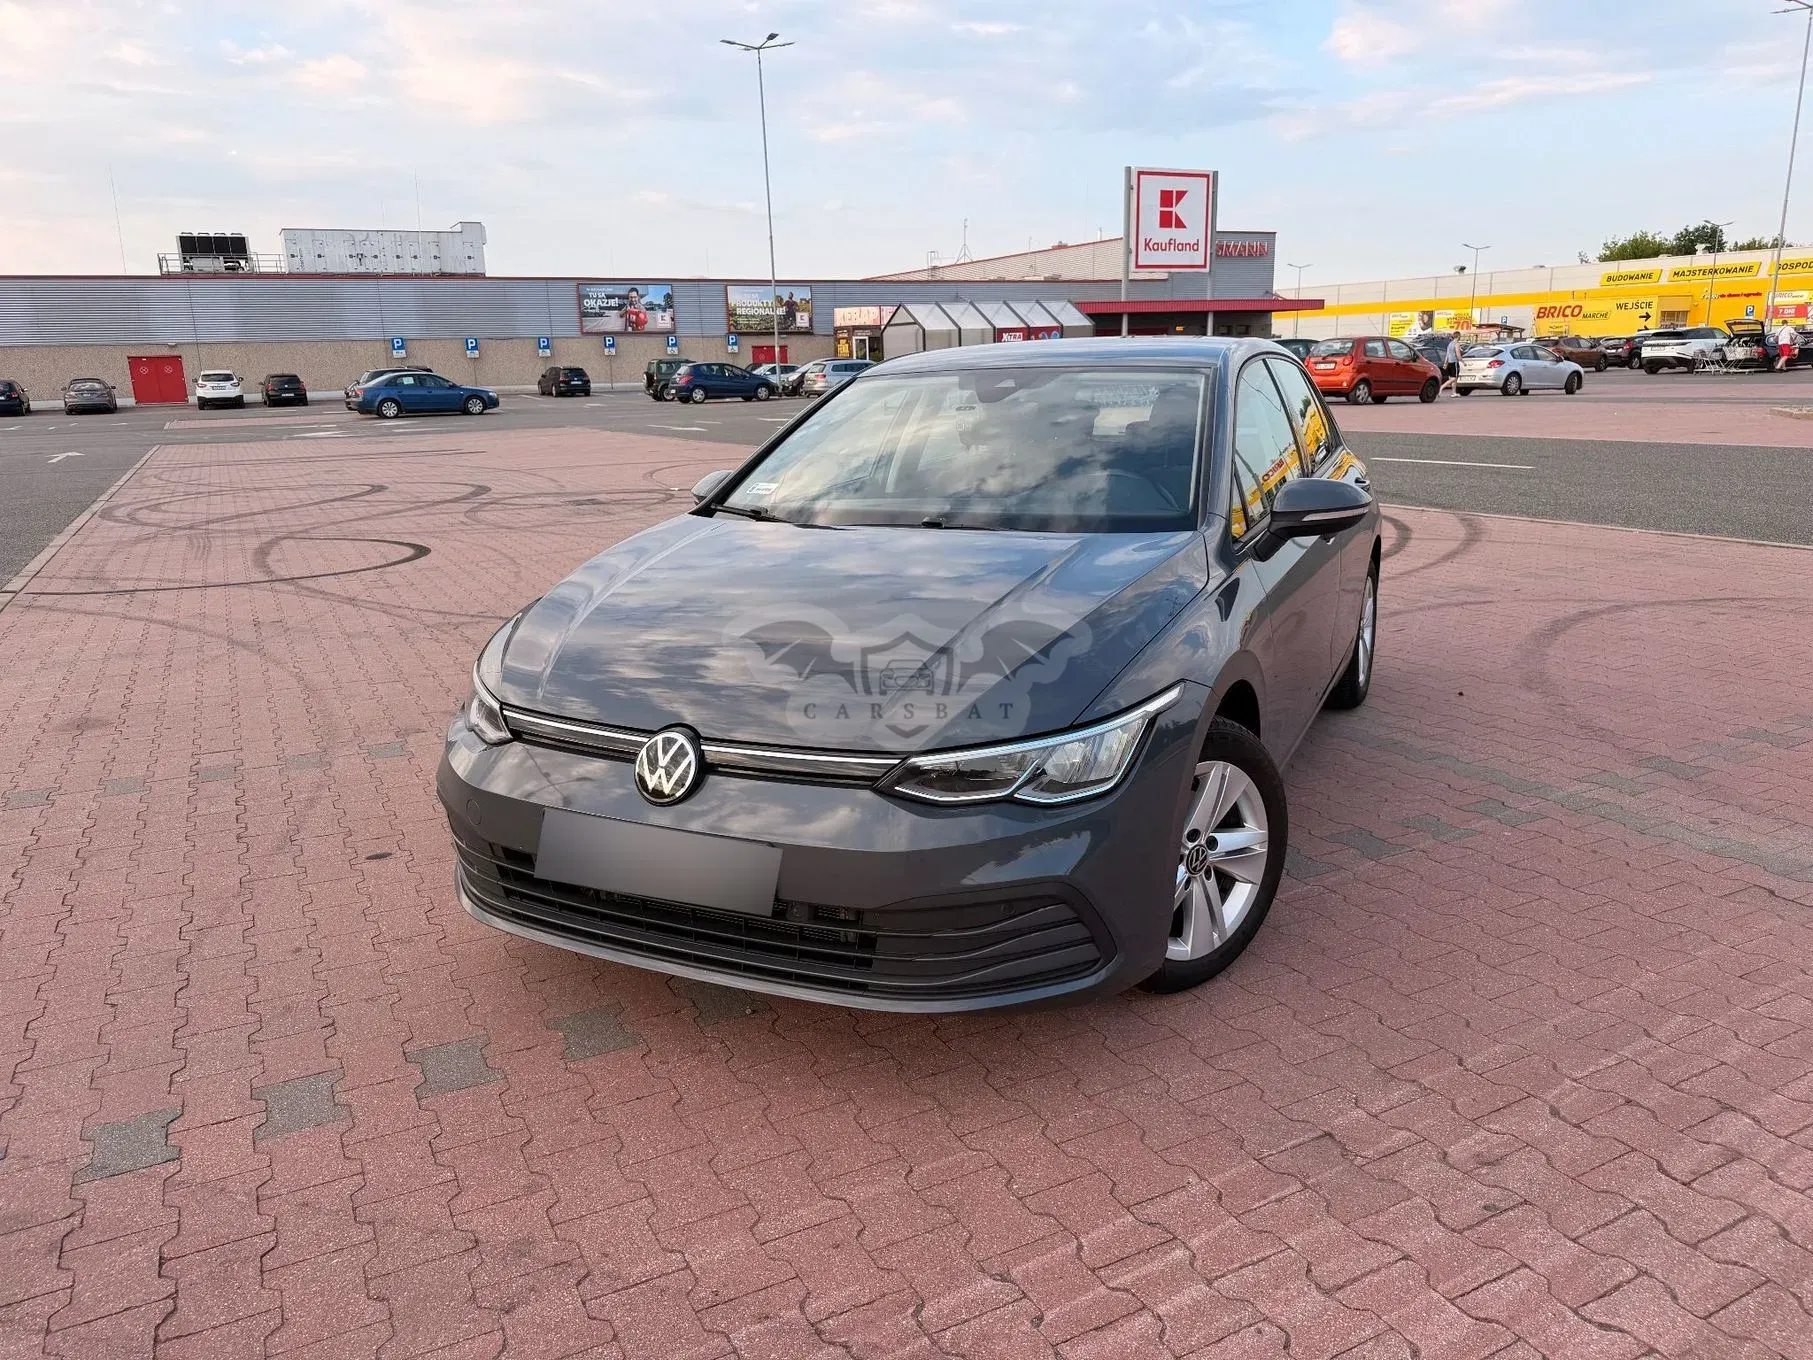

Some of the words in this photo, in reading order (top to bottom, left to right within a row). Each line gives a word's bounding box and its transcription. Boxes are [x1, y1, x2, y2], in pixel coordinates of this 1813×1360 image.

[1144, 238, 1200, 253] Kaufland
[1673, 266, 1754, 278] MAJSTERKOWANIE
[1607, 273, 1653, 282] BUDOWANIE
[583, 298, 619, 308] OKAZJE!
[1616, 300, 1654, 310] WEJŚCIE
[1537, 305, 1582, 319] BRICO
[393, 338, 402, 349] P
[468, 338, 476, 349] P
[540, 338, 548, 348] P
[605, 337, 613, 347] P
[669, 336, 676, 346] P
[729, 335, 736, 345] P
